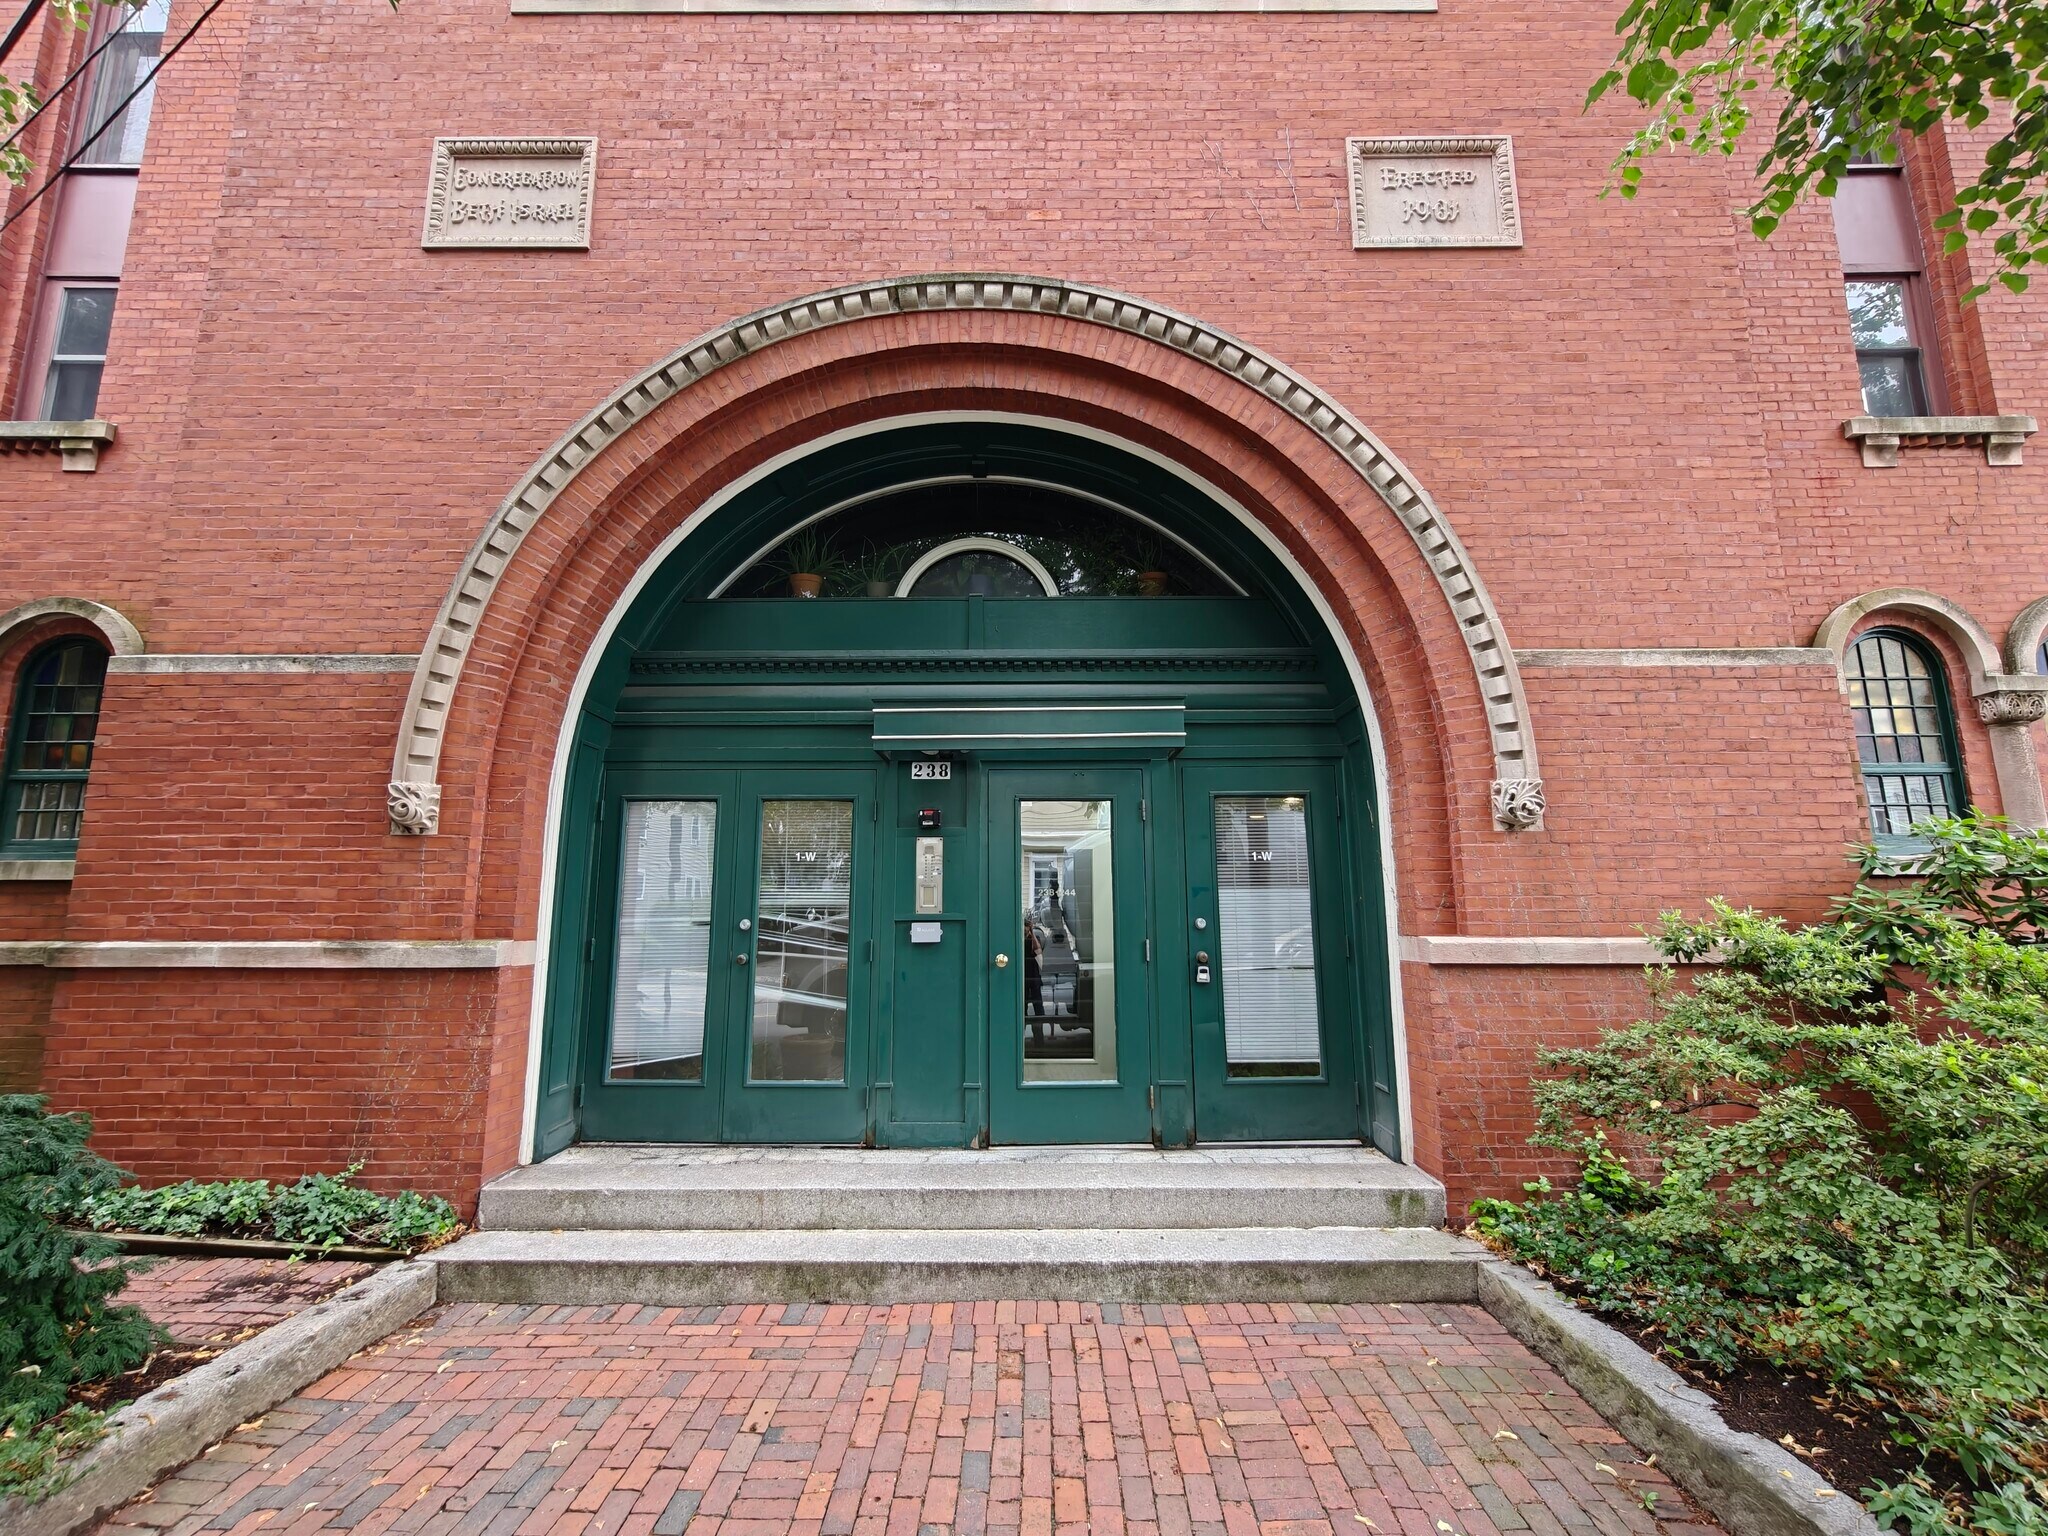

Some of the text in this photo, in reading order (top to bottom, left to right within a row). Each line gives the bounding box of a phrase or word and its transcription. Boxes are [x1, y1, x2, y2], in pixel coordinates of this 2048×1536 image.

[1380, 167, 1477, 191] ERECTED
[451, 199, 575, 224] BETH ISRAEL
[913, 763, 949, 778] 238
[795, 851, 817, 862] 1-W
[1251, 851, 1273, 861] 1-W
